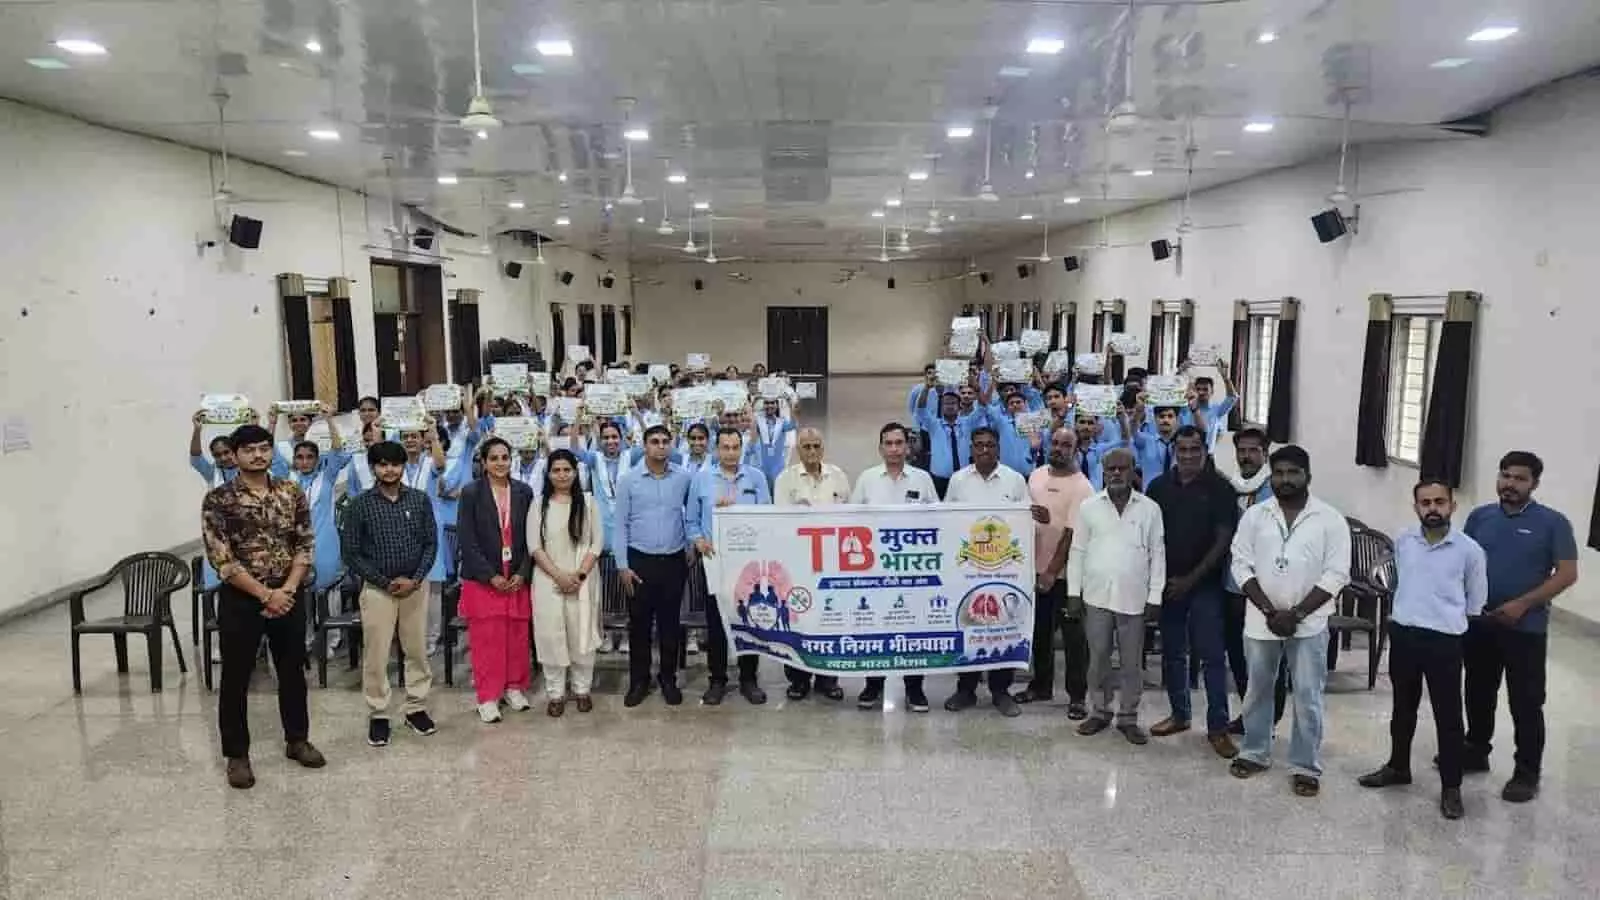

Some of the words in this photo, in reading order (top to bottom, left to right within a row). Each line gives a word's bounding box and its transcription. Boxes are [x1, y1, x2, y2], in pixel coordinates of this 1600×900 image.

[797, 526, 875, 573] TB
[878, 527, 940, 552] मुक्त
[879, 552, 943, 571] भारत
[801, 639, 834, 654] नगर
[839, 636, 884, 655] निगम
[888, 635, 956, 655] भीलवाड़ा
